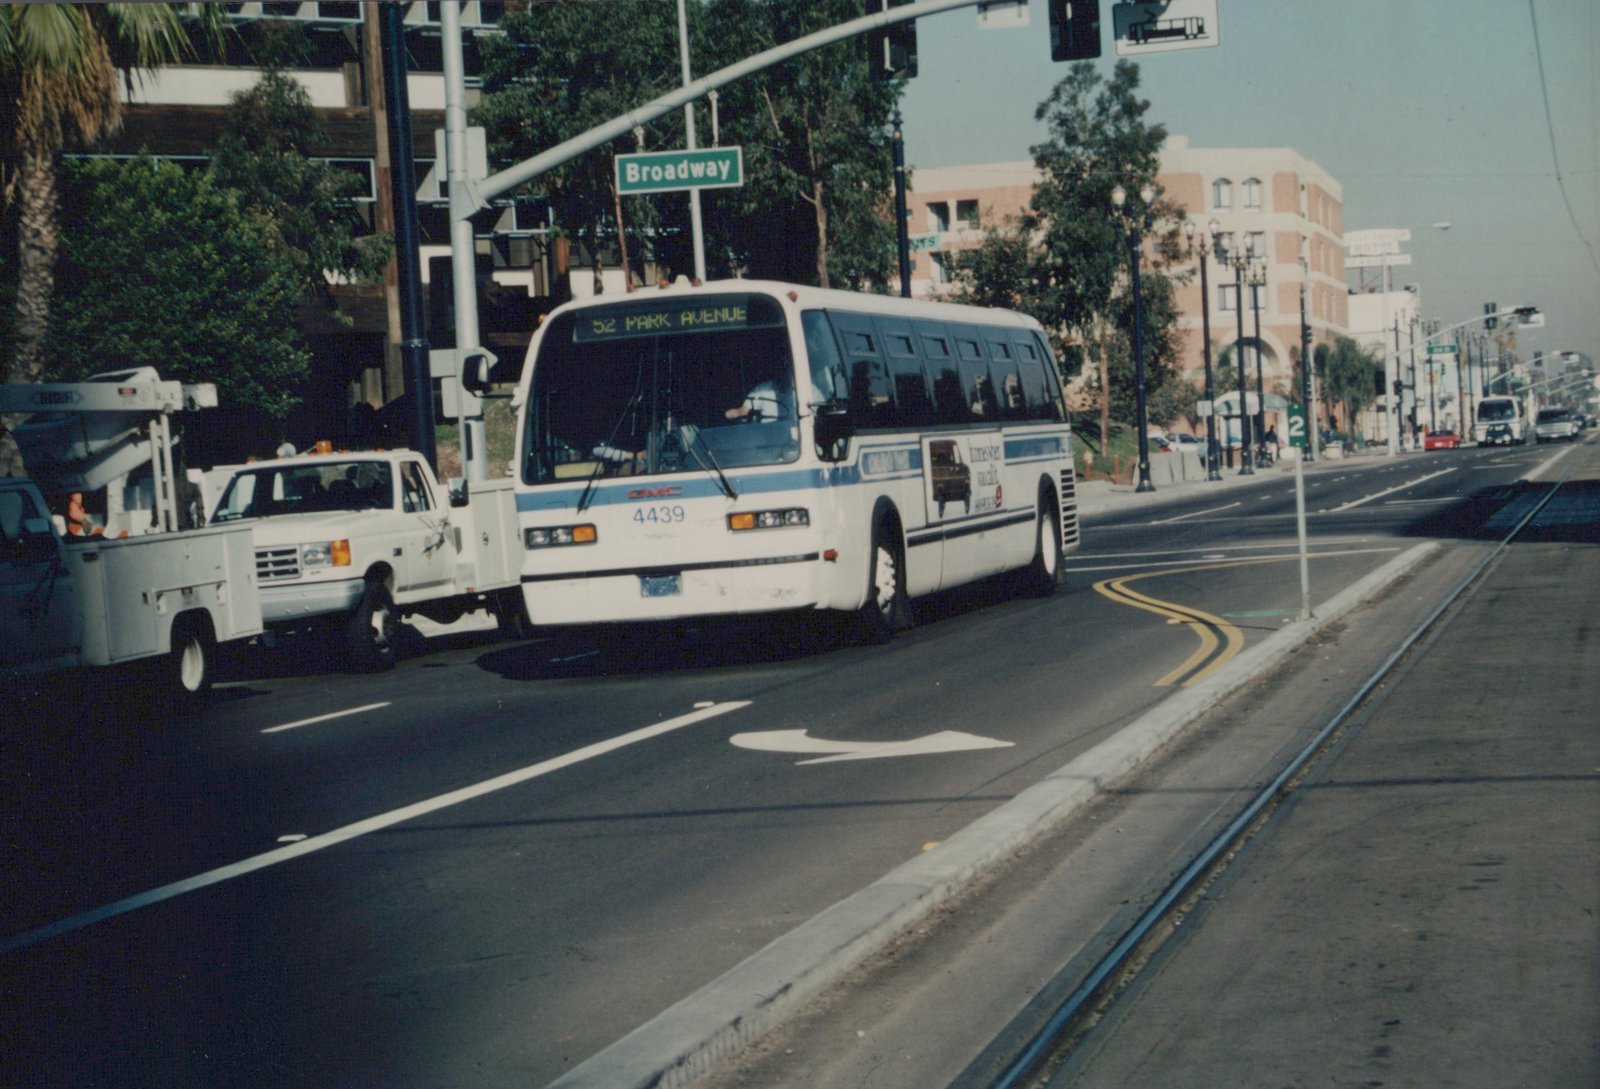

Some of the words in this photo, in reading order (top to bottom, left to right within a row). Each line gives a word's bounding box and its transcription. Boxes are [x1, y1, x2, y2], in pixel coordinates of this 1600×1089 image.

[626, 160, 730, 183] Broadway
[592, 318, 616, 334] 52
[626, 313, 671, 331] PARK
[681, 306, 747, 326] AVENUE
[1289, 415, 1304, 437] 2
[628, 486, 682, 499] GMC
[633, 505, 685, 524] 4439
